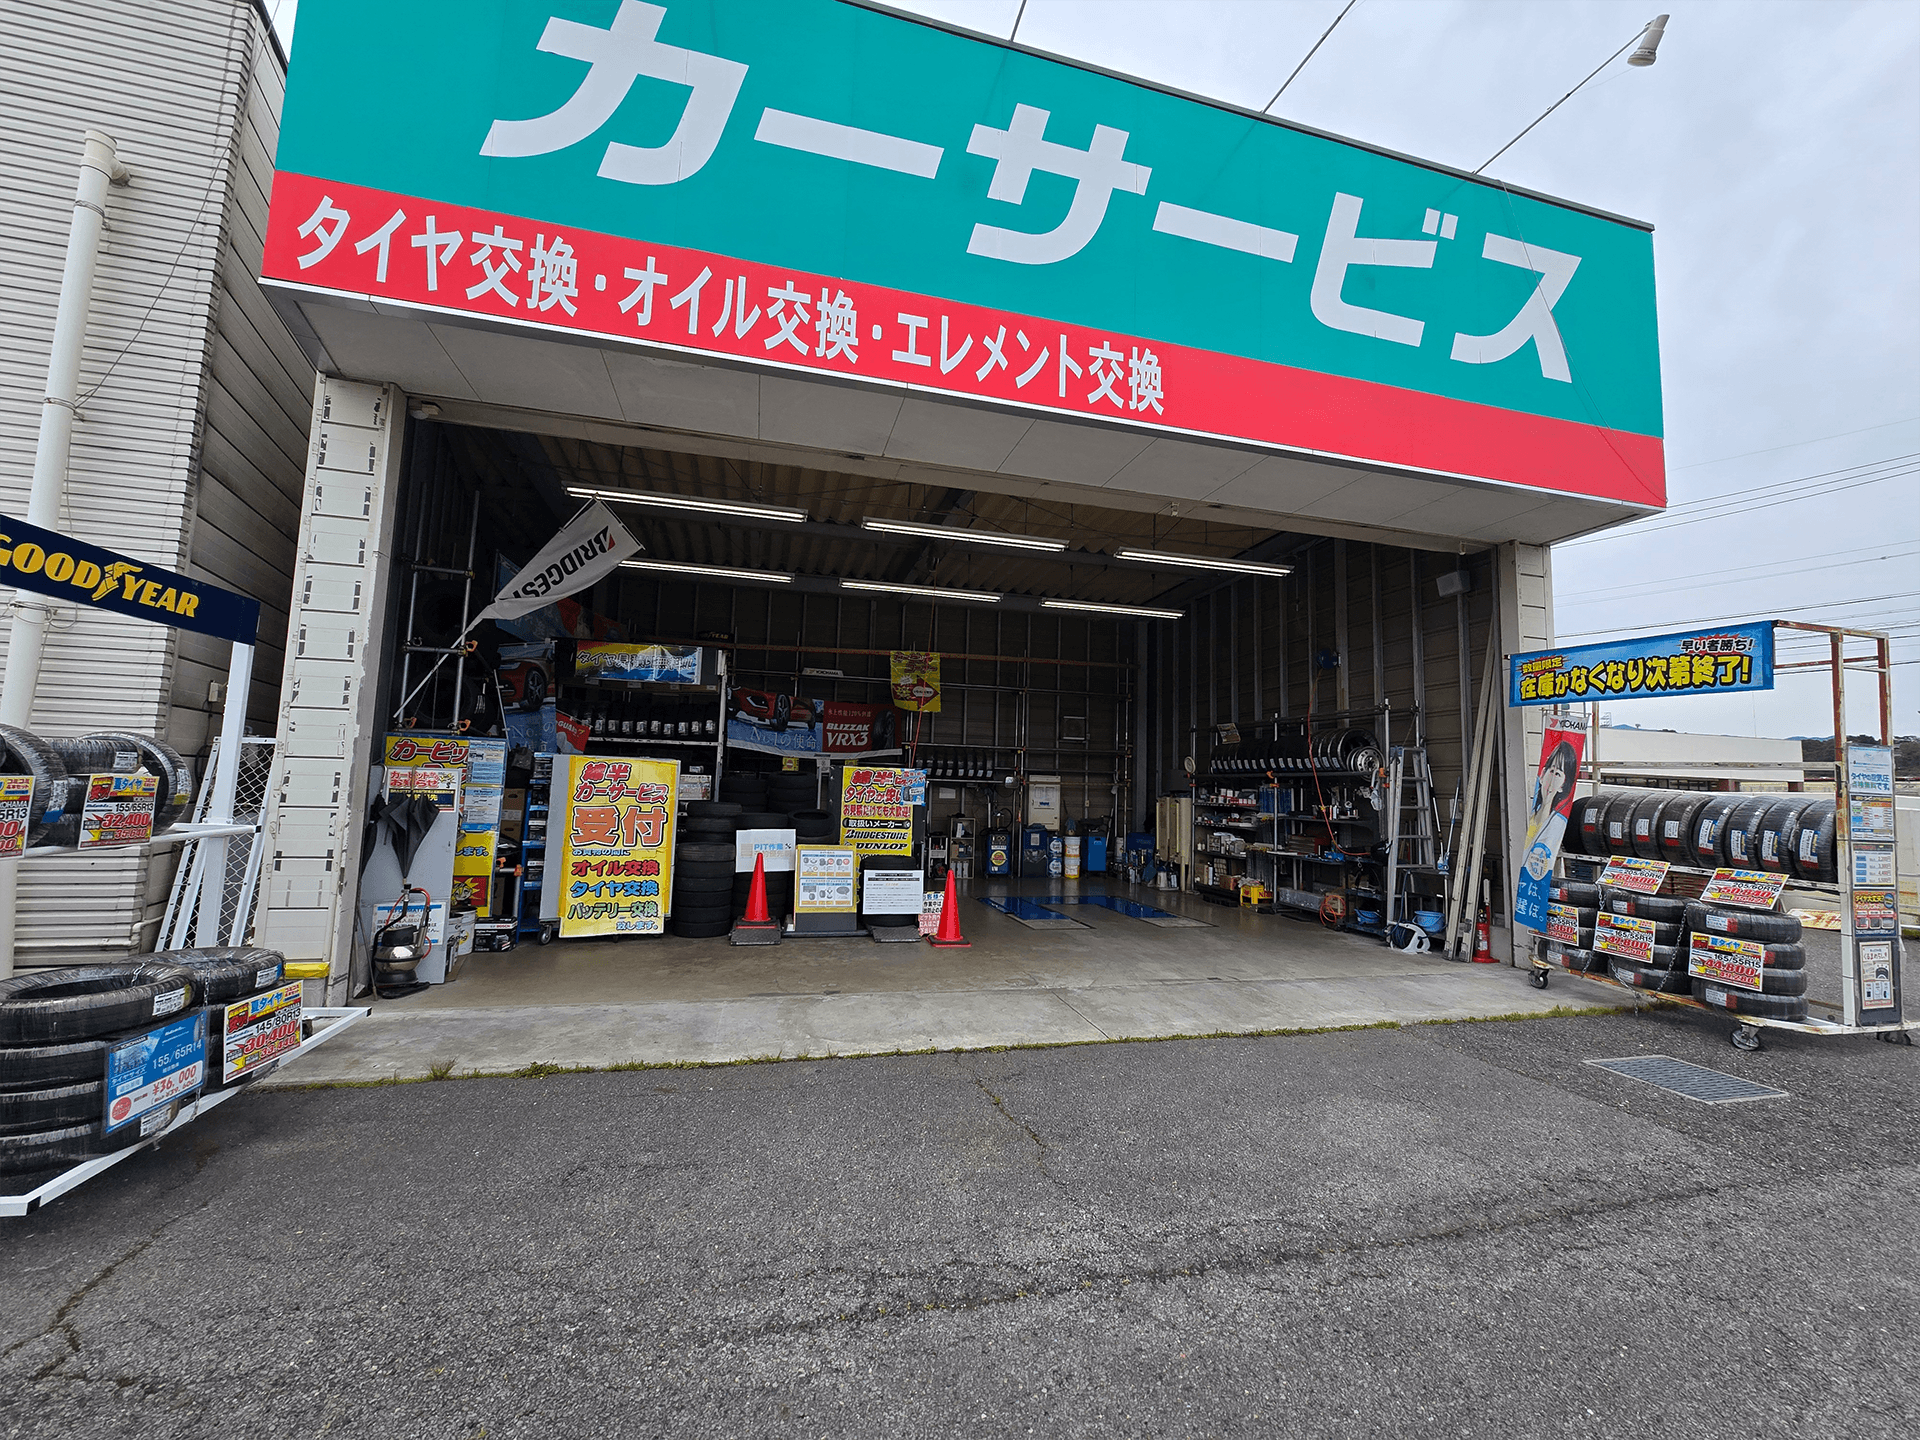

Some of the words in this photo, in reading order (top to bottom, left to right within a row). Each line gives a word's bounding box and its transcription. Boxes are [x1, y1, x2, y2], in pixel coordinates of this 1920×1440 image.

[480, 0, 1583, 384] カーサービス
[296, 195, 1165, 416] タイヤ交換・オイル交換・エレメント交換
[1681, 638, 1754, 652] 早い者勝ち!
[1521, 655, 1752, 699] 在庫がなくなり次第終了!
[826, 722, 870, 732] BLIZZAK
[826, 731, 869, 748] VRX3
[573, 782, 668, 804] カーサービス
[115, 803, 154, 812] 155/65R13
[101, 812, 151, 828] 32,400
[570, 806, 668, 846] 受付
[845, 829, 908, 840] BRIDGESTONE
[856, 842, 908, 850] DUNLOP
[571, 859, 660, 877] オイル交換
[570, 880, 659, 898] タイヤ交換
[567, 901, 658, 919] バッテリー交換
[1714, 952, 1762, 969] 165/55R15
[255, 1008, 301, 1034] 145/80R13
[243, 1019, 297, 1054] 30,400
[152, 1039, 202, 1070] 155/65R14
